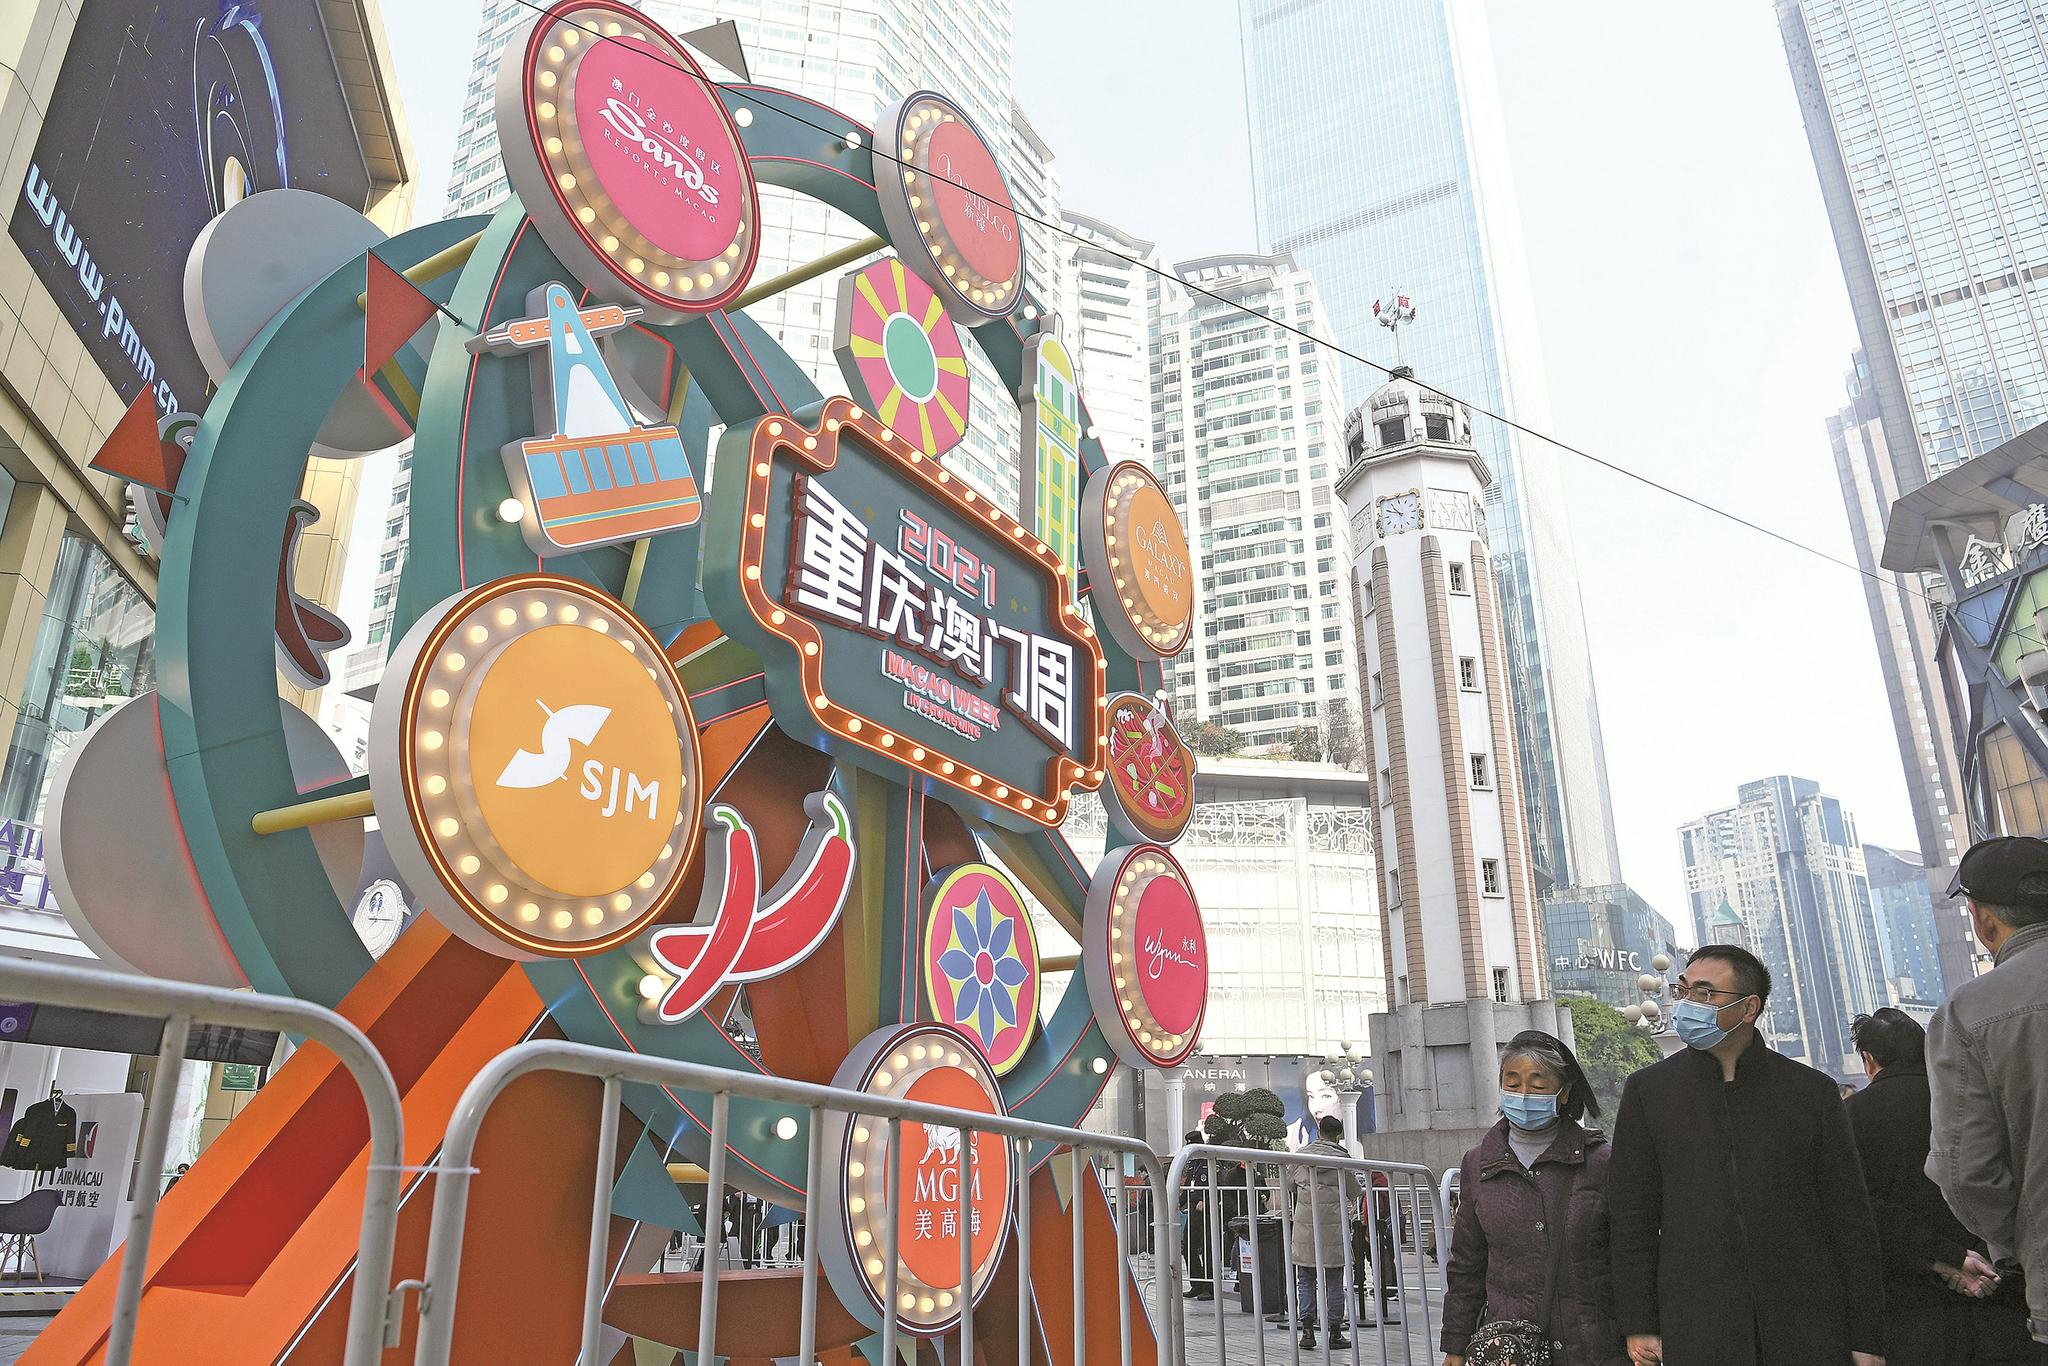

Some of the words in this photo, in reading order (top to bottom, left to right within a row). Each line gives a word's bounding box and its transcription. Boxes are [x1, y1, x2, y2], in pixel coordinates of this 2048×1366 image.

[598, 97, 720, 205] Sands
[612, 76, 721, 176] 澳门金沙度假区
[604, 128, 668, 186] RESORTS
[674, 186, 717, 223] MACAO
[899, 508, 996, 610] 2021
[1136, 526, 1186, 580] GALAXY
[798, 474, 1073, 752] 重庆澳门周
[882, 648, 951, 704] MACAO
[951, 685, 1001, 732] WEEK
[904, 690, 919, 712] IN
[917, 696, 982, 742] CHONGQING
[580, 759, 660, 820] SJM
[1597, 948, 1642, 972] WFC
[1181, 1082, 1246, 1092] 纳海
[1182, 1069, 1246, 1080] ANERAI
[56, 1168, 73, 1185] AIR
[72, 1168, 104, 1187] MACAU
